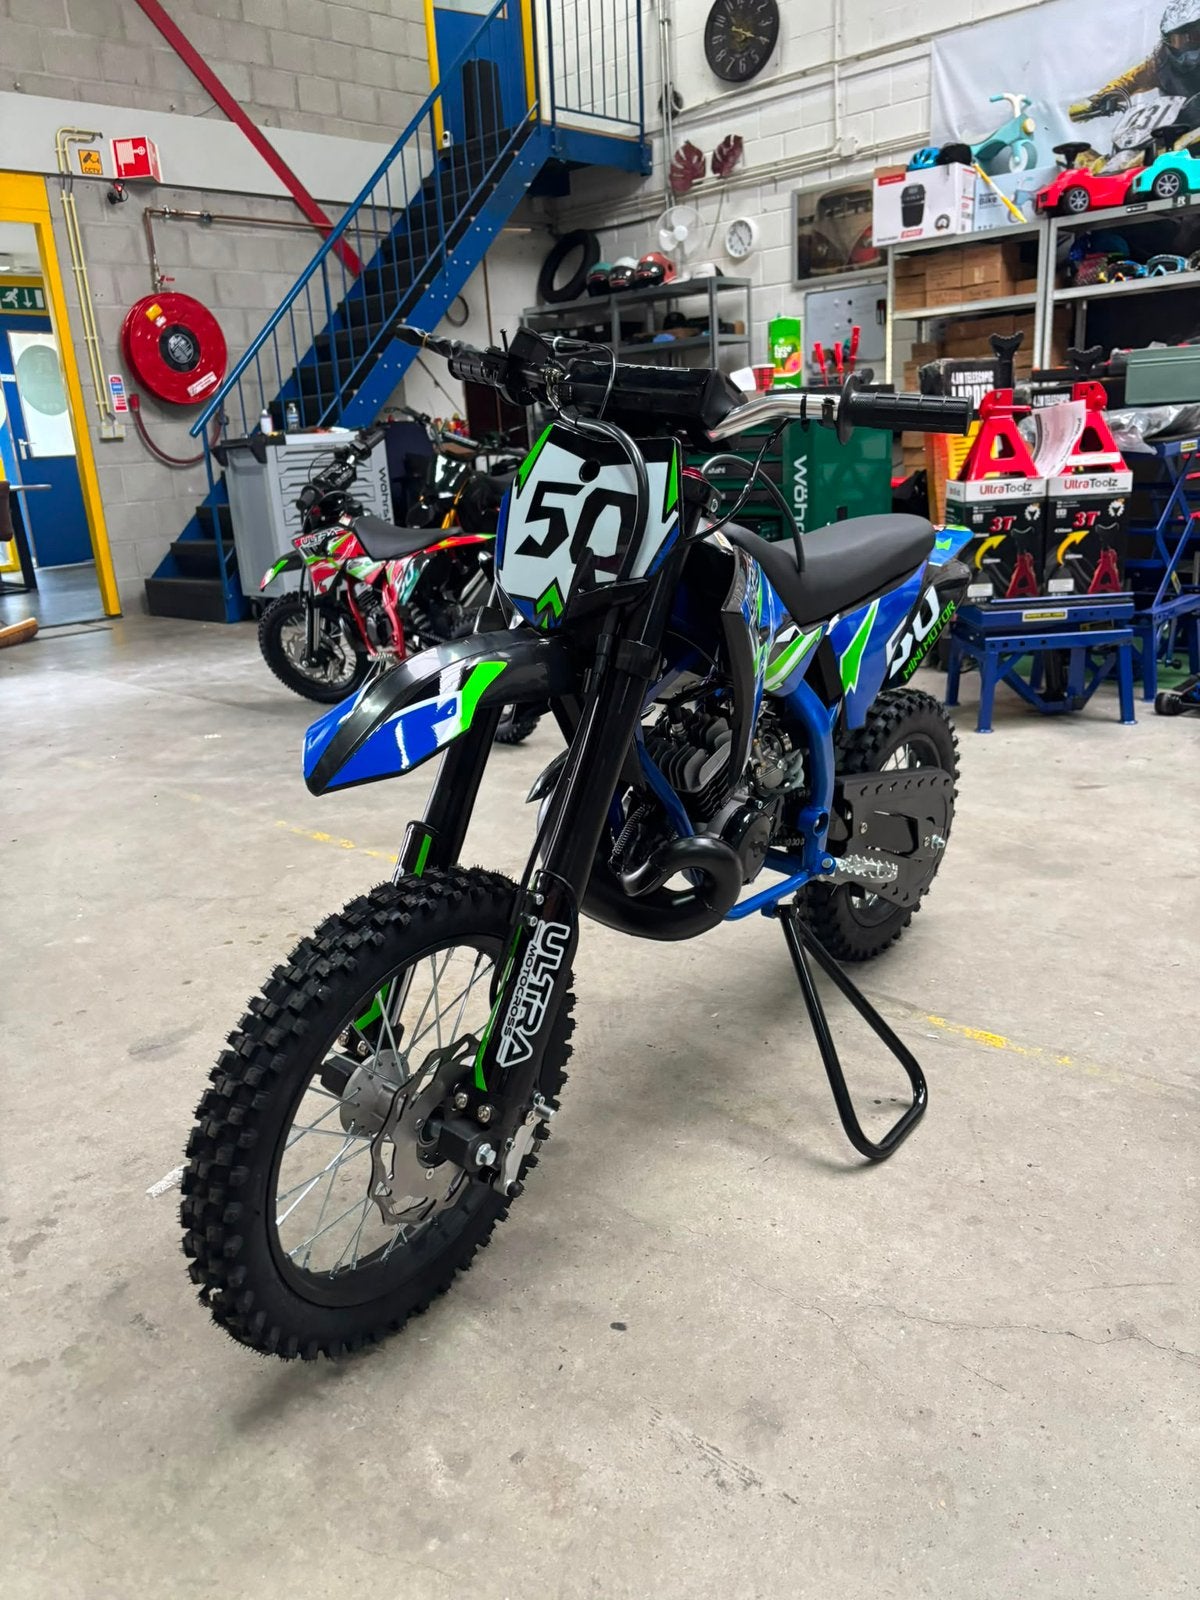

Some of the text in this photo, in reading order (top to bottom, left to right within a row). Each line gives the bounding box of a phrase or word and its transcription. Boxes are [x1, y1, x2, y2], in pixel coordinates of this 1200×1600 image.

[980, 482, 1032, 495] UltraToolz
[1064, 477, 1119, 490] UltraToolz
[514, 480, 641, 577] 50
[988, 515, 1017, 532] 3T
[1072, 511, 1101, 528] 3T
[903, 600, 956, 680] MINI MOTOR
[496, 920, 571, 1068] ULTRA
[503, 943, 539, 1038] MOTOCROSS
